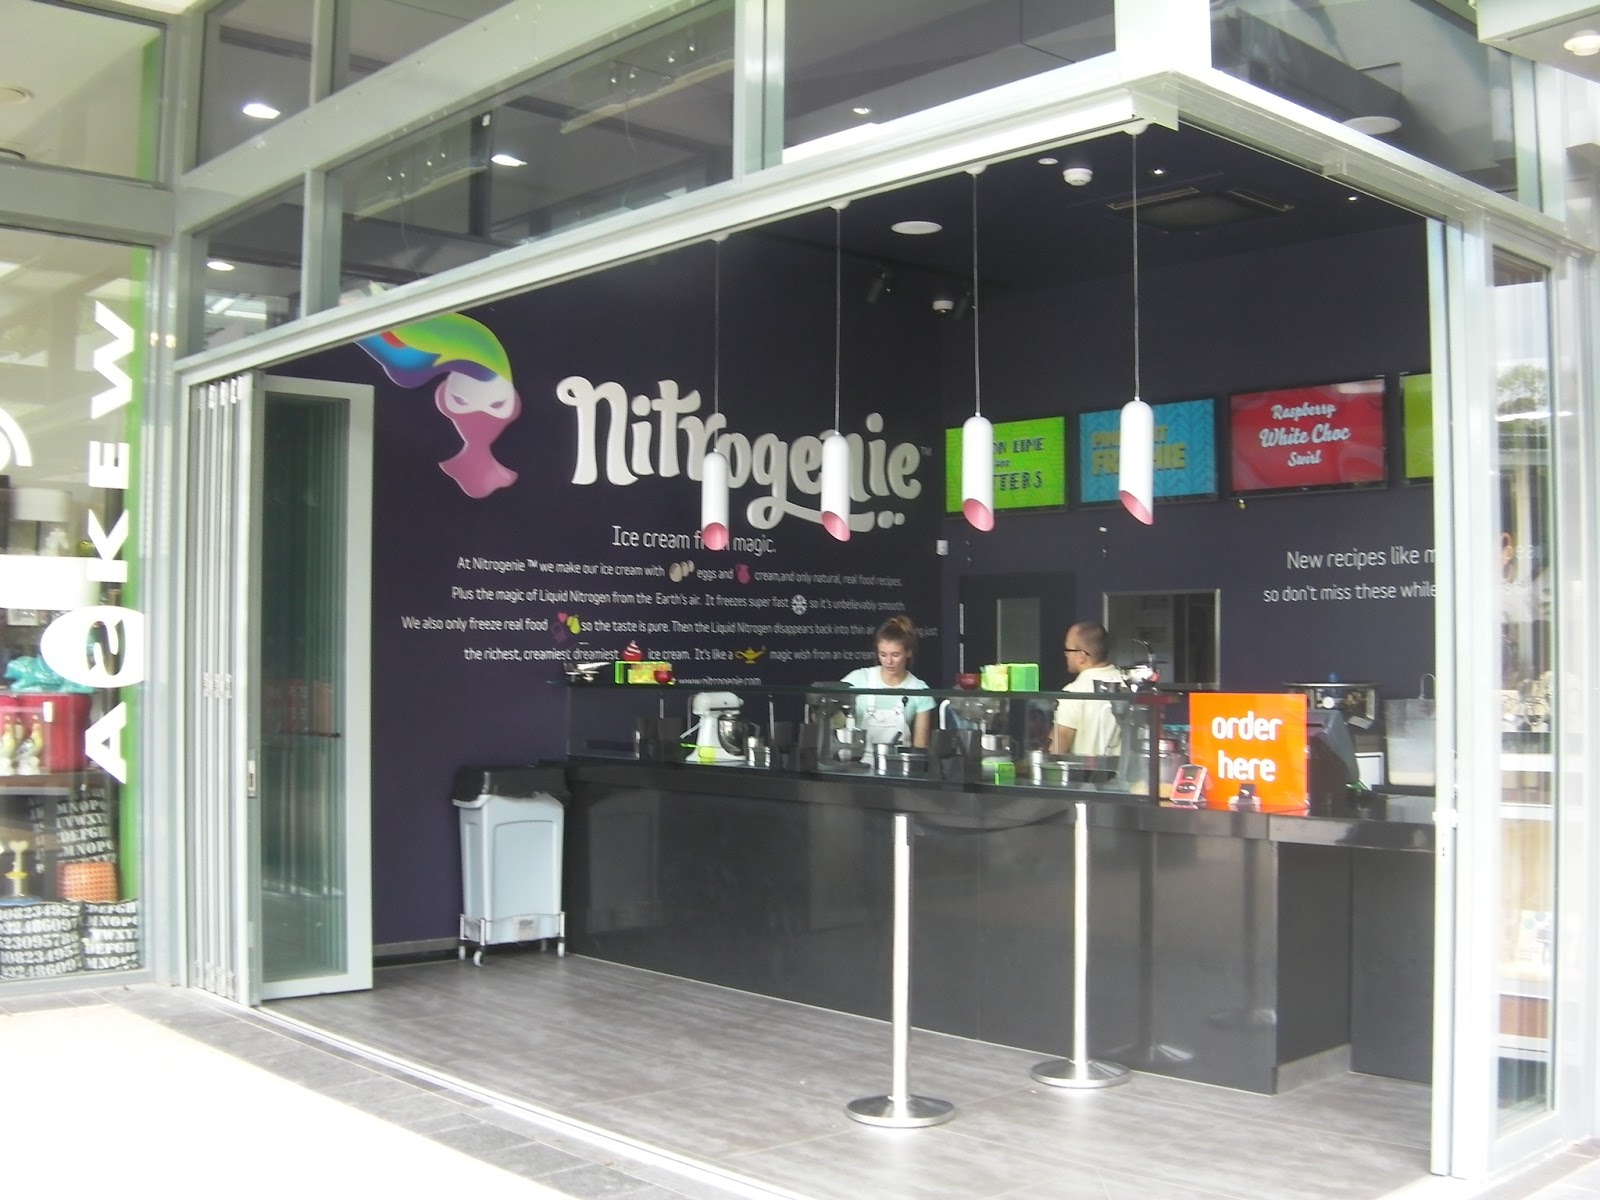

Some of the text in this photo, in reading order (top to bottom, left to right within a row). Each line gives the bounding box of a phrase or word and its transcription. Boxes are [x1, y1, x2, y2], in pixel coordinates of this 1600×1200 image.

[1271, 401, 1337, 421] Raspberry
[1258, 422, 1351, 448] White Choc
[1286, 449, 1322, 467] Swirl
[612, 525, 640, 547] Ice
[642, 531, 691, 550] cream
[732, 534, 777, 557] magic.
[456, 556, 472, 571] At
[472, 557, 526, 574] Nitrogenie
[539, 562, 554, 573] we
[555, 561, 582, 575] make
[582, 565, 600, 576] our
[599, 562, 614, 576] ice
[614, 565, 644, 577] cream
[643, 565, 666, 578] with
[696, 568, 718, 582] eggs
[717, 568, 735, 581] and
[1286, 551, 1324, 570] New
[1326, 548, 1386, 571] recipes
[1390, 545, 1420, 565] like
[451, 585, 475, 600] Plus
[475, 587, 495, 601] the
[494, 588, 526, 604] magic
[525, 588, 539, 602] of
[538, 589, 569, 605] Liquid
[568, 589, 612, 606] Nitrogen
[611, 591, 636, 604] from
[635, 592, 653, 605] the
[655, 592, 688, 606] Earth's
[704, 593, 716, 607] It
[715, 594, 748, 607] freezes
[747, 597, 772, 610] super
[771, 595, 790, 608] fast
[1263, 589, 1280, 602] so
[1281, 585, 1318, 601] don't
[1320, 584, 1352, 600] miss
[1354, 583, 1397, 599] these
[400, 616, 421, 630] We
[421, 616, 445, 631] also
[444, 617, 468, 633] only
[468, 616, 503, 631] freeze
[502, 618, 524, 632] real
[524, 617, 549, 632] food
[580, 621, 594, 633] so
[594, 619, 613, 633] the
[612, 620, 639, 633] taste
[638, 620, 647, 633] is
[671, 620, 695, 634] Then
[693, 621, 711, 634] the
[710, 621, 737, 636] Liquid
[736, 622, 773, 637] Nitrogen
[463, 647, 484, 661] the
[647, 648, 662, 661] ice
[1211, 711, 1283, 741] order
[1218, 750, 1276, 782] here
